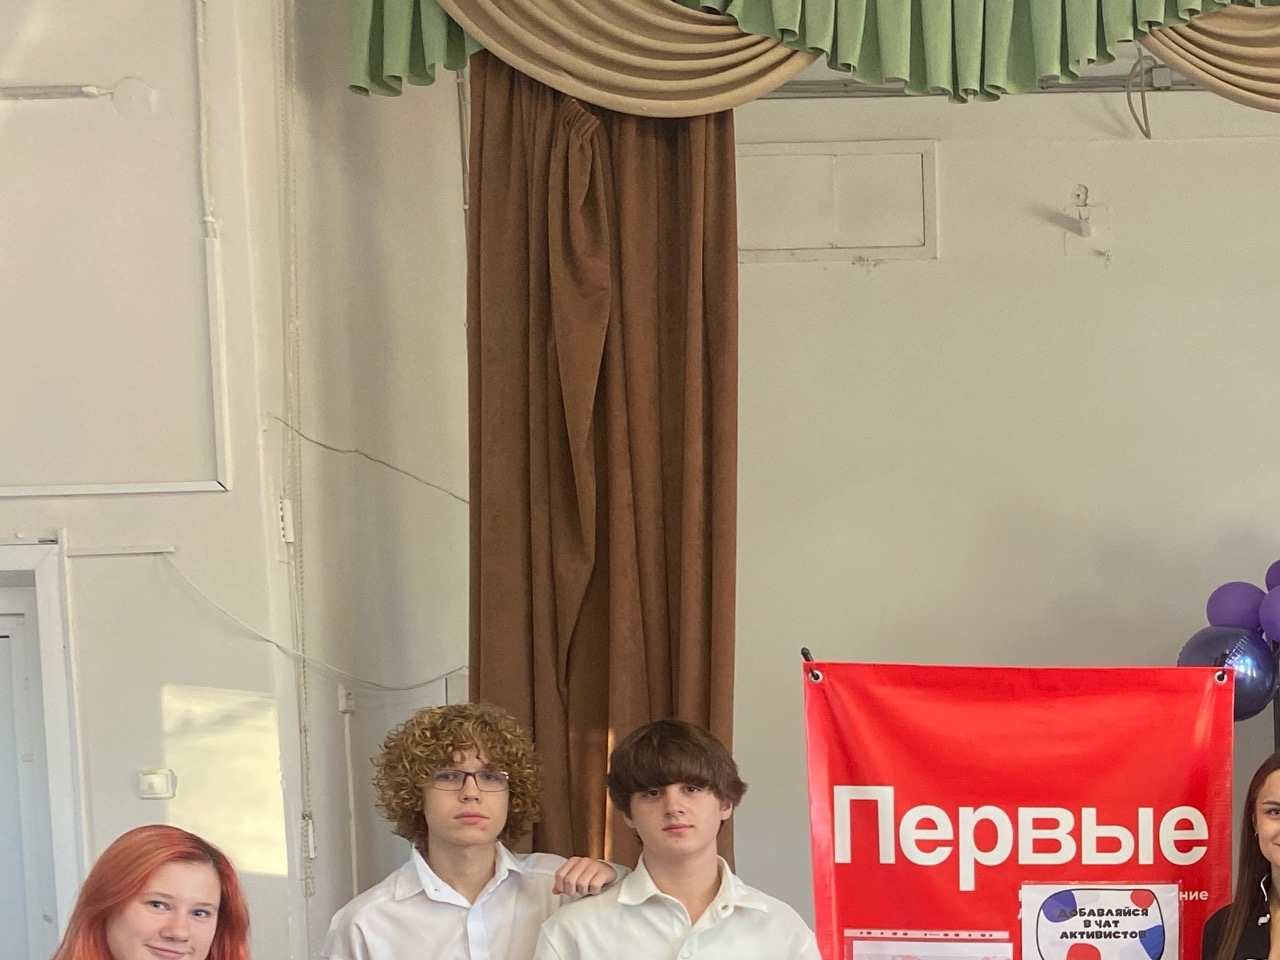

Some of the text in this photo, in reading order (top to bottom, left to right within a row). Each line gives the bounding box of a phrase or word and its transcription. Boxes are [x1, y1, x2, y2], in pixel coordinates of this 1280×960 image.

[833, 785, 1209, 891] Первые
[1057, 907, 1149, 919] ДОБАВЛЯЙСЯ
[1083, 920, 1120, 928] В ЧАТ
[1060, 930, 1146, 939] АКТИВИСТОВ
